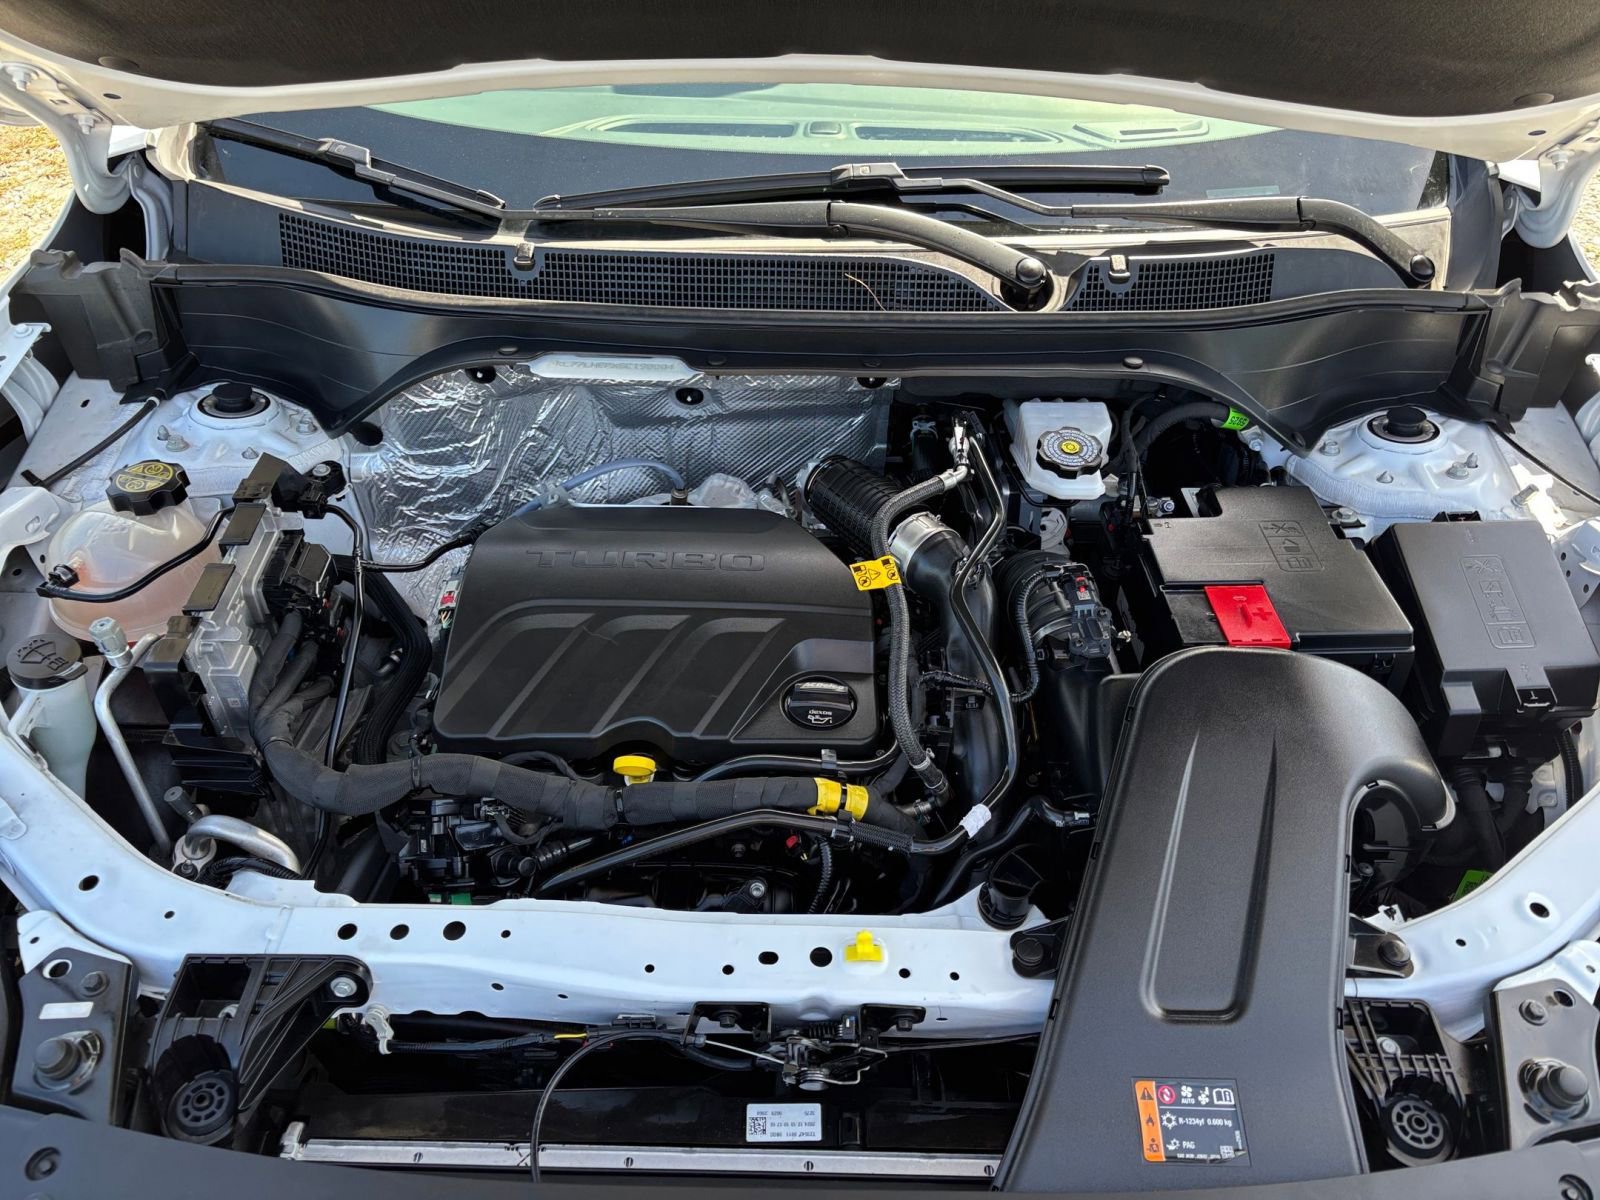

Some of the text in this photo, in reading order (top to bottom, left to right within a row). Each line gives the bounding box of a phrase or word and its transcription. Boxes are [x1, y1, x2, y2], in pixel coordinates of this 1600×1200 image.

[526, 550, 765, 571] TURBO
[1178, 1117, 1232, 1127] R-1234yf 0.600 kg
[1182, 1141, 1196, 1149] PAG
